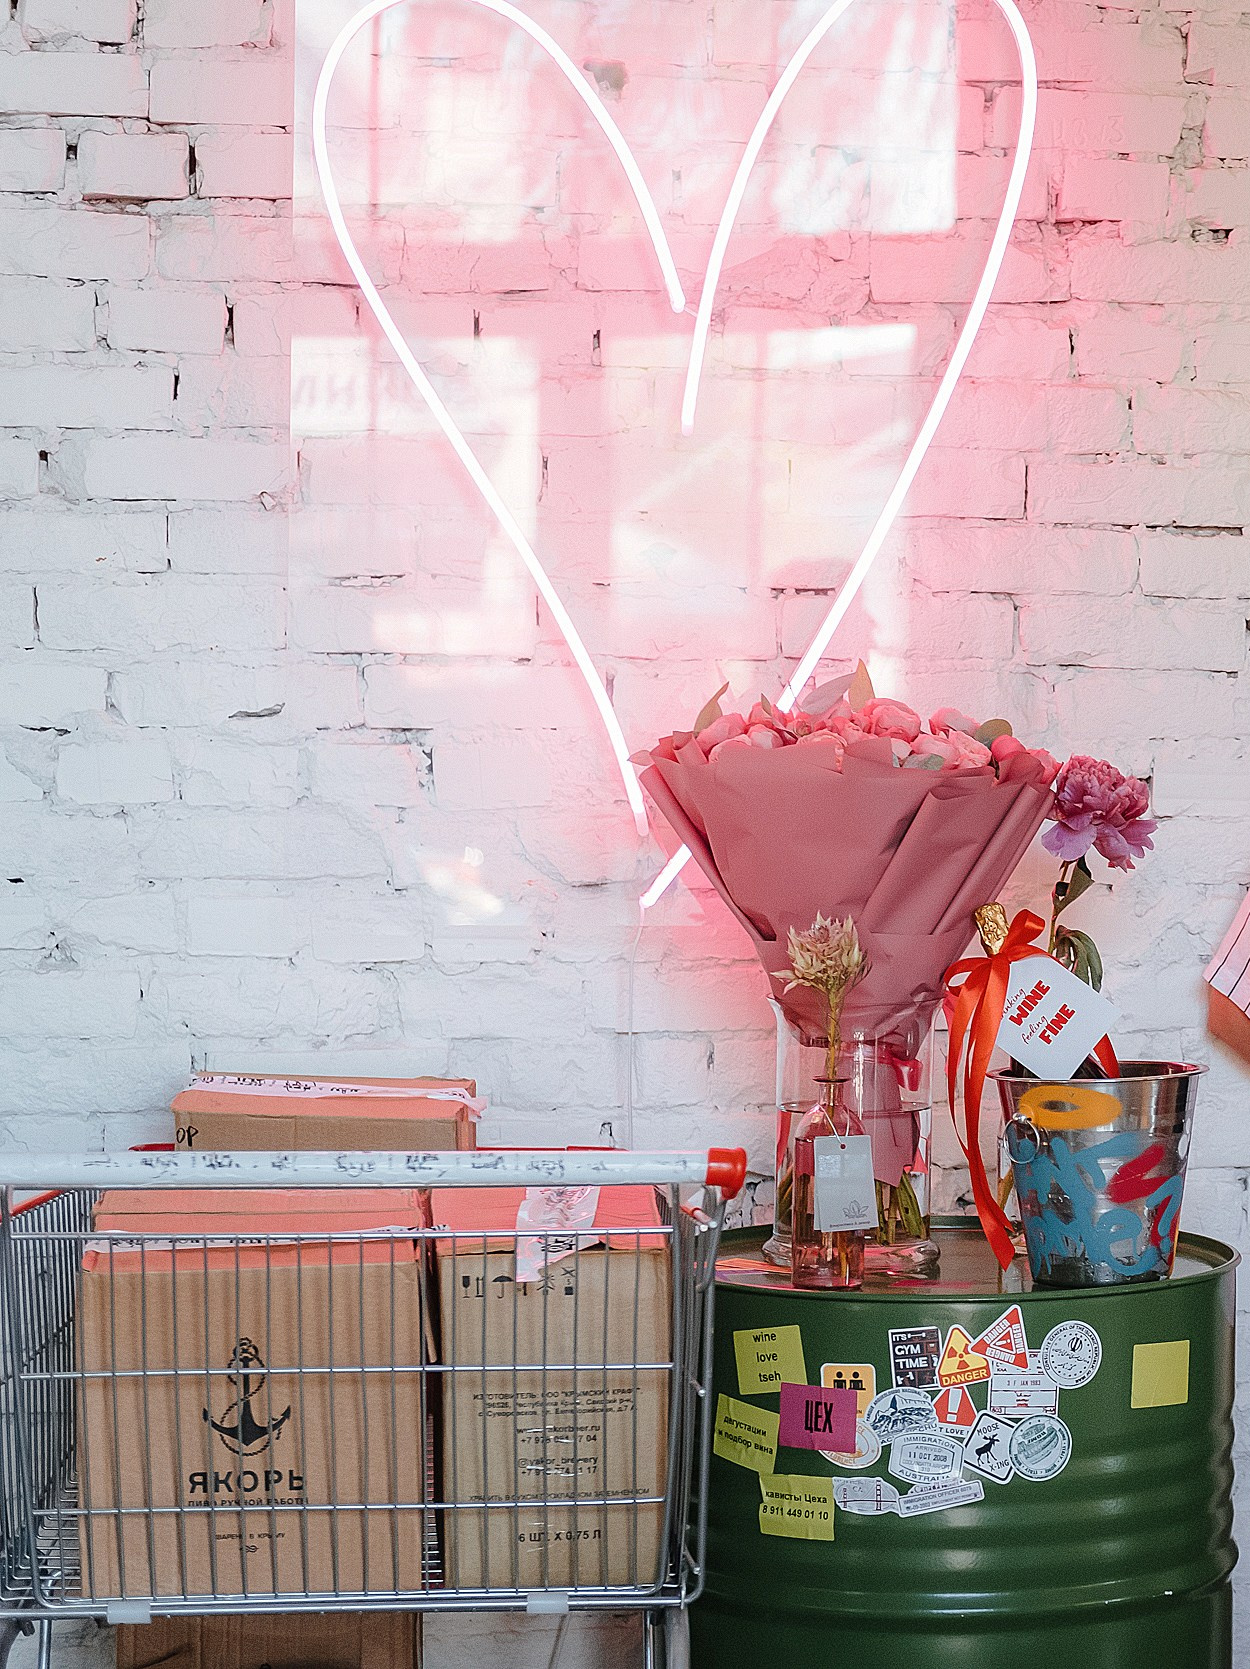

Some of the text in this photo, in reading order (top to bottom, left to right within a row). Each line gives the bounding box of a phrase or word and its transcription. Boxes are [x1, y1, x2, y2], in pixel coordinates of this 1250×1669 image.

[1008, 979, 1051, 1027] WINE
[1021, 1015, 1049, 1045] feeling
[1038, 1003, 1076, 1045] FINE
[752, 1332, 777, 1343] wine
[894, 1343, 922, 1356] GYM
[756, 1351, 778, 1363] love
[895, 1356, 929, 1369] TIME
[758, 1370, 781, 1382] tseh
[942, 1369, 989, 1386] DANGER
[804, 1399, 834, 1434] ЦЕХ
[723, 1415, 767, 1437] дегустации
[976, 1422, 1001, 1436] MOOSE
[586, 1434, 597, 1442] 04
[724, 1431, 752, 1449] подбор
[754, 1443, 774, 1455] вина
[903, 1436, 956, 1450] IMMIGRATION
[908, 1451, 916, 1459] 11
[918, 1452, 931, 1461] OCT
[587, 1466, 597, 1474] 17
[188, 1469, 305, 1494] ЯКОРЬ
[765, 1490, 827, 1504] кависты Цеха
[762, 1505, 829, 1520] 8 911 449 01 10
[519, 1533, 525, 1542] 6
[592, 1529, 602, 1540] Л
